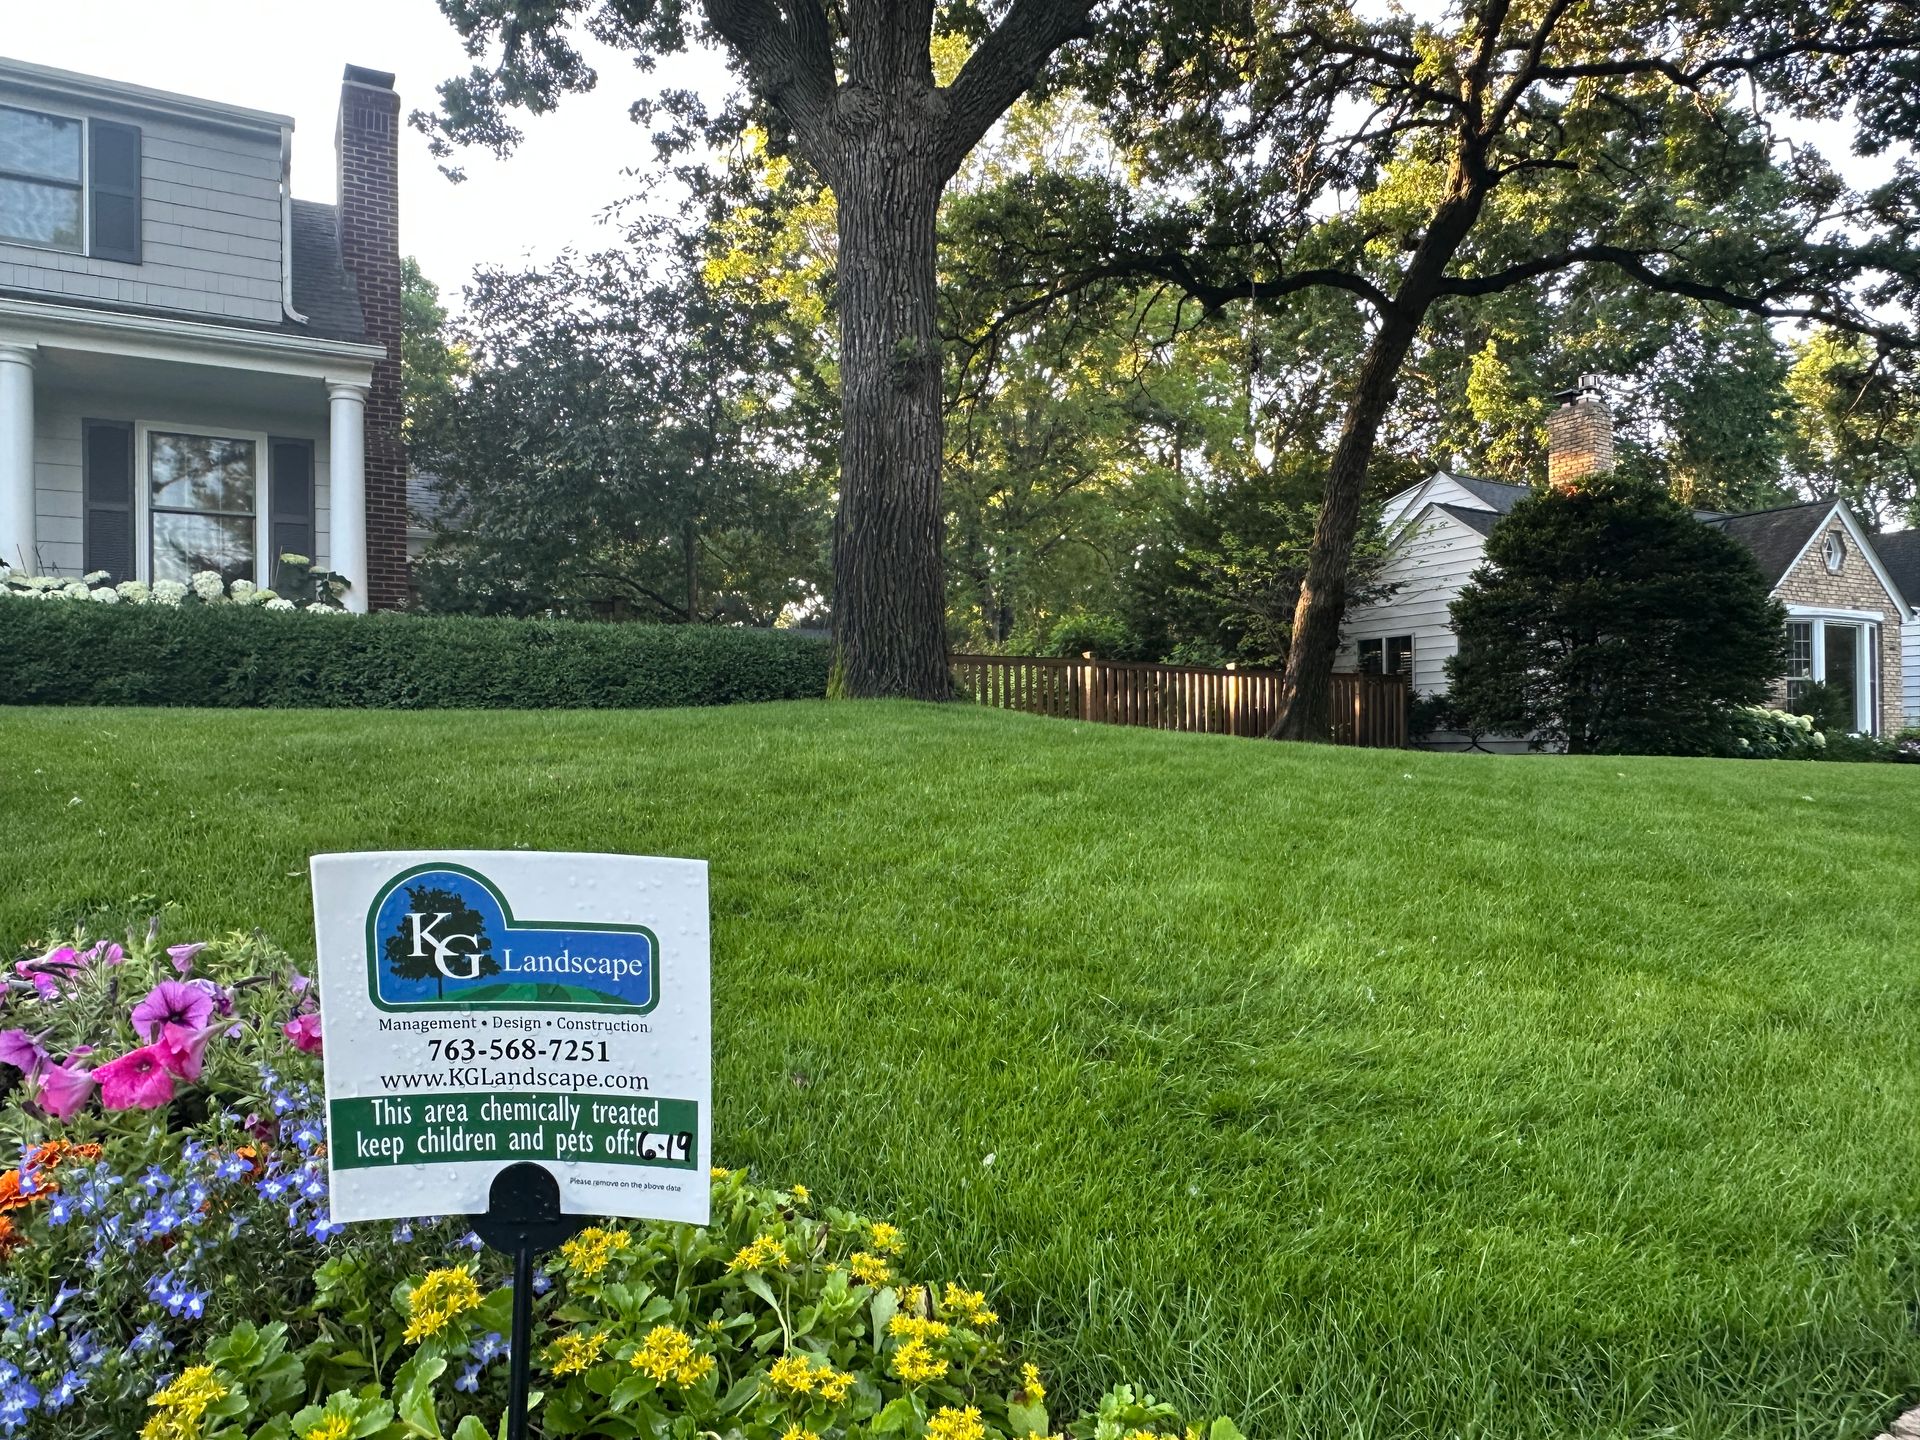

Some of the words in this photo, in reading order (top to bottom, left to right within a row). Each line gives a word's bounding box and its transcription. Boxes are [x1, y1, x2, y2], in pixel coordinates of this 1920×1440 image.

[405, 912, 484, 980] KG
[503, 949, 643, 982] Landscape
[379, 1017, 477, 1033] Management
[492, 1016, 541, 1031] Design
[557, 1017, 648, 1033] Construction
[428, 1038, 610, 1062] 763-568-7251
[380, 1066, 649, 1091] www.KGLandscape.com
[371, 1097, 412, 1126] This
[425, 1103, 468, 1123] area
[480, 1094, 580, 1130] chemically
[592, 1100, 659, 1127] treated
[357, 1131, 404, 1164] keep
[417, 1125, 496, 1154] children
[508, 1124, 543, 1150] and
[556, 1130, 593, 1159] pets
[605, 1128, 635, 1155] off:
[569, 1177, 591, 1186] Please
[592, 1179, 619, 1188] remove
[630, 1181, 642, 1189] the
[643, 1182, 665, 1191] above
[665, 1184, 682, 1193] date
